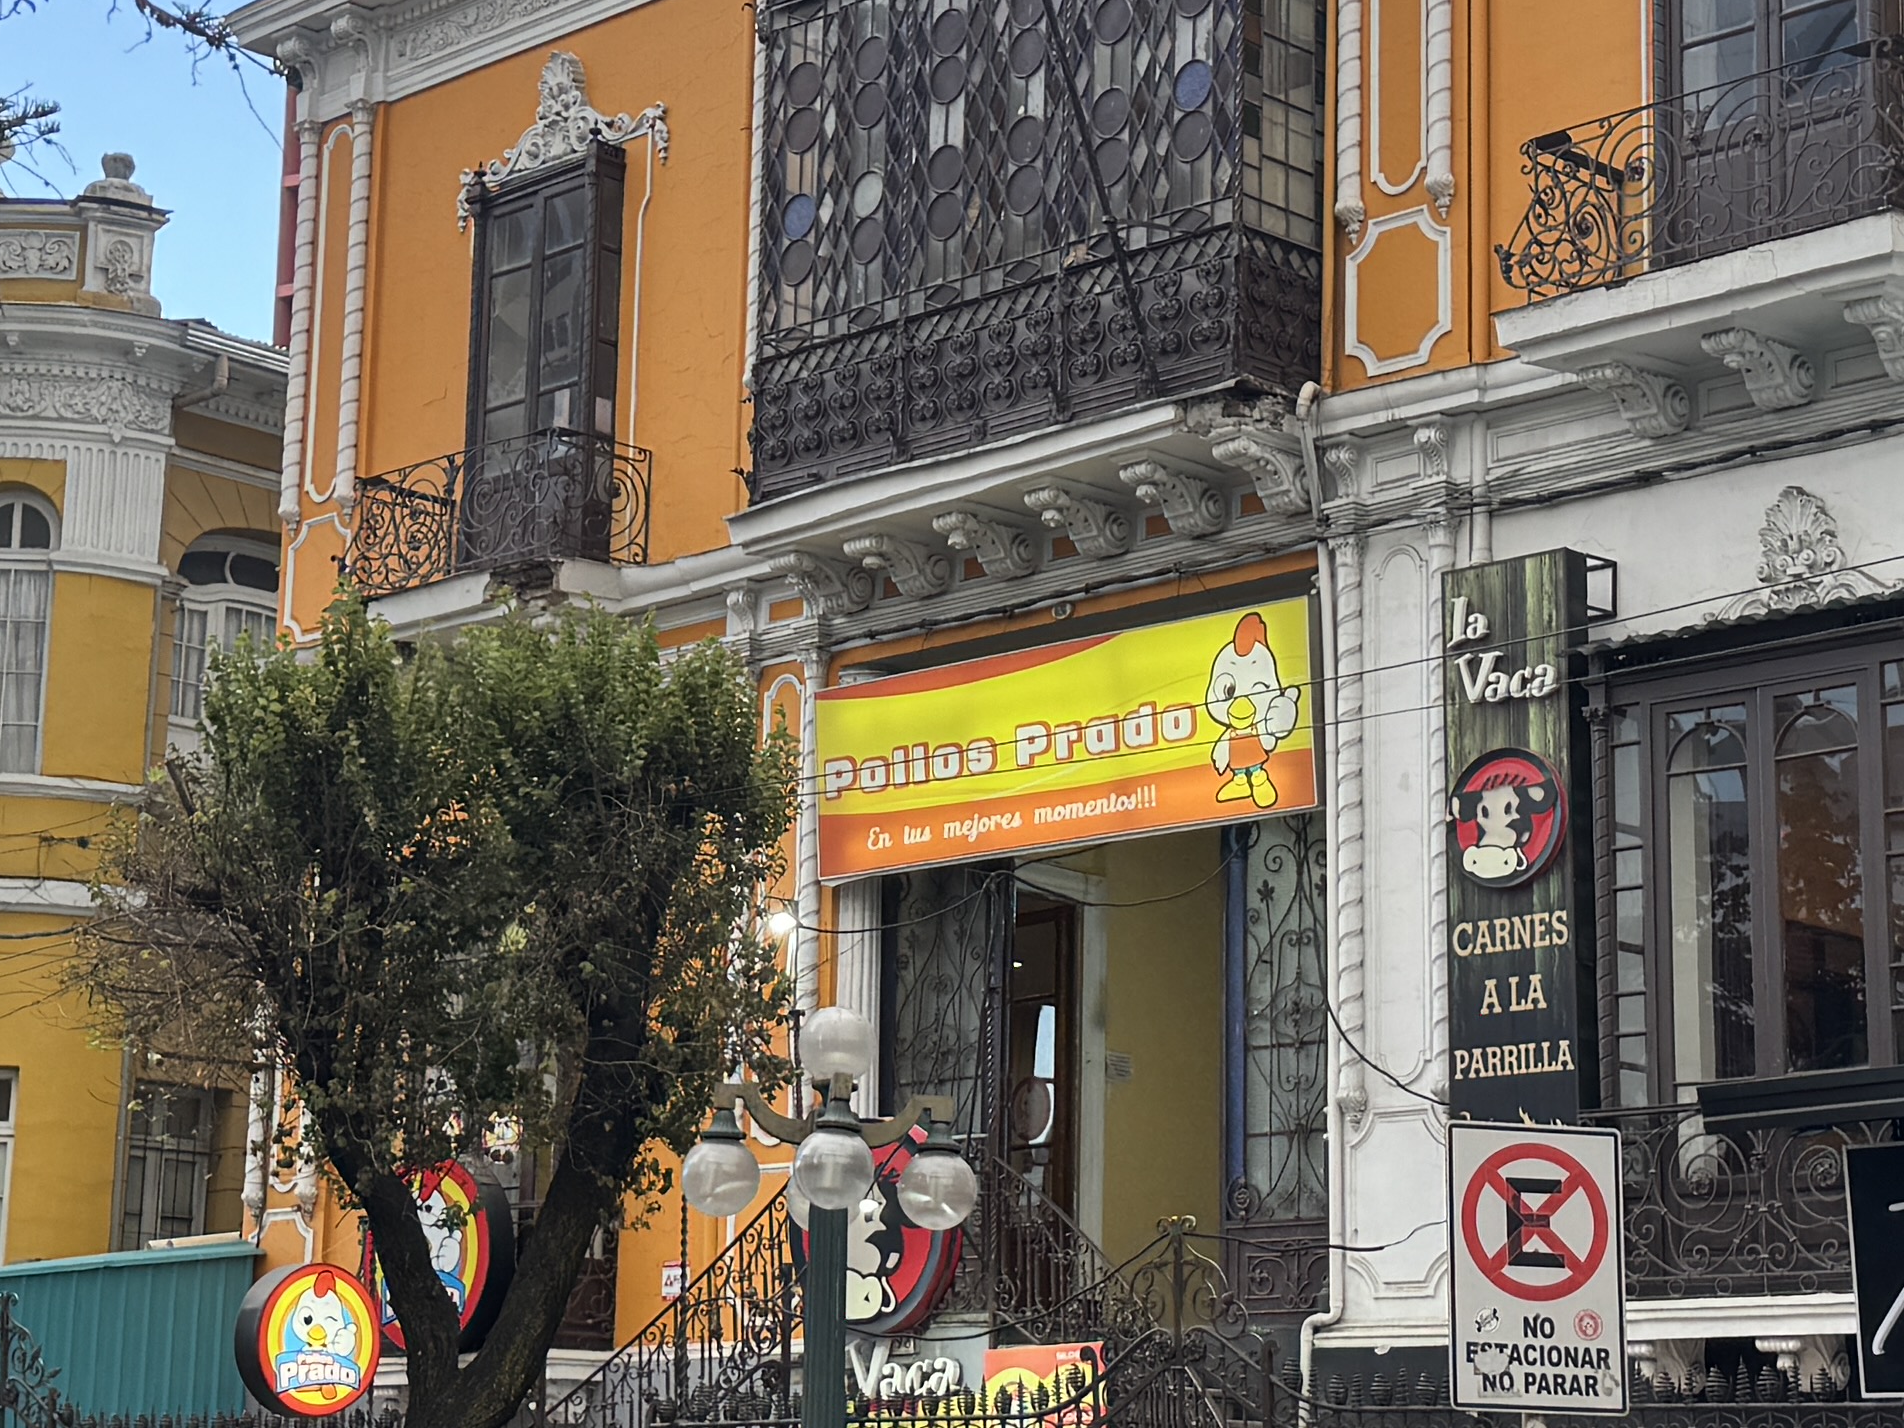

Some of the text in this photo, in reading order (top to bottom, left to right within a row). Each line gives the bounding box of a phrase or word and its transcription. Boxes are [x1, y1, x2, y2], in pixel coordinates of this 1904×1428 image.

[1454, 651, 1561, 703] Vaca
[824, 702, 1198, 801] Pollos Prado
[867, 784, 1157, 851] En tus mejores momentos!!!
[1452, 910, 1569, 957] CARNES
[1480, 973, 1548, 1015] A LA
[1454, 1039, 1575, 1080] PARRILLA
[1523, 1316, 1555, 1339] NO
[279, 1361, 356, 1389] Prado
[845, 1338, 963, 1400] Vaca
[1466, 1341, 1611, 1370] EACIONAR
[1482, 1373, 1599, 1397] NO PARAR
